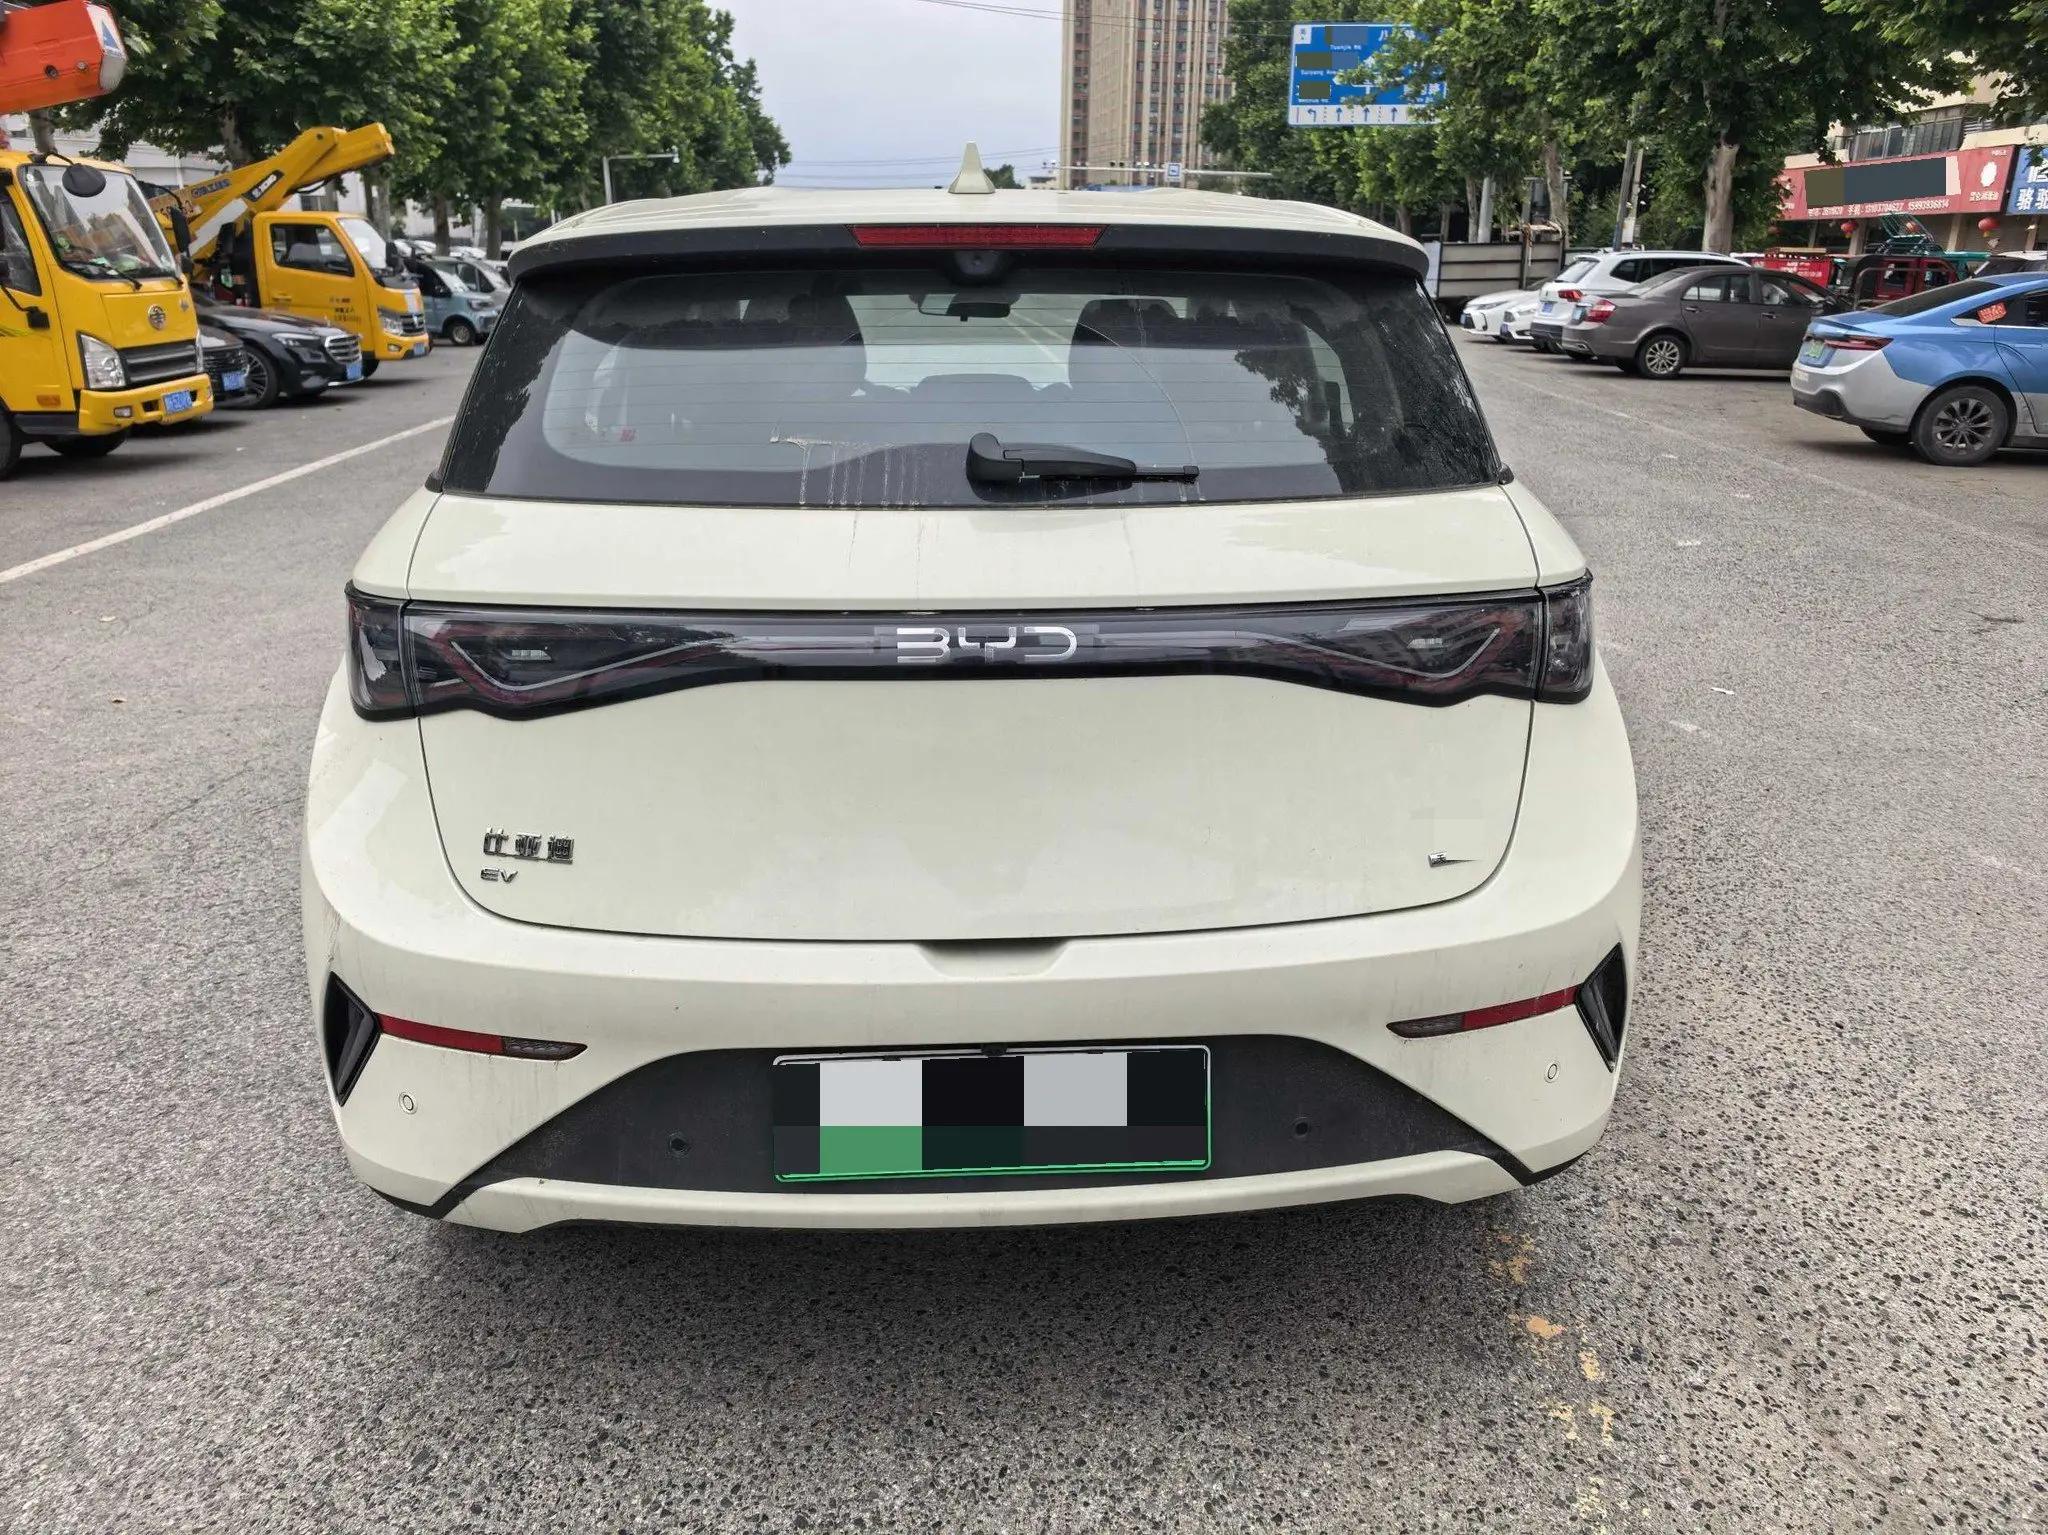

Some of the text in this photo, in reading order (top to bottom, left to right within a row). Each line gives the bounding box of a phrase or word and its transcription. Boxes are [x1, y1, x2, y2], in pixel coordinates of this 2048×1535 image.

[896, 626, 1078, 663] BYD
[483, 826, 575, 865] 比亚迪
[480, 867, 518, 883] EV
